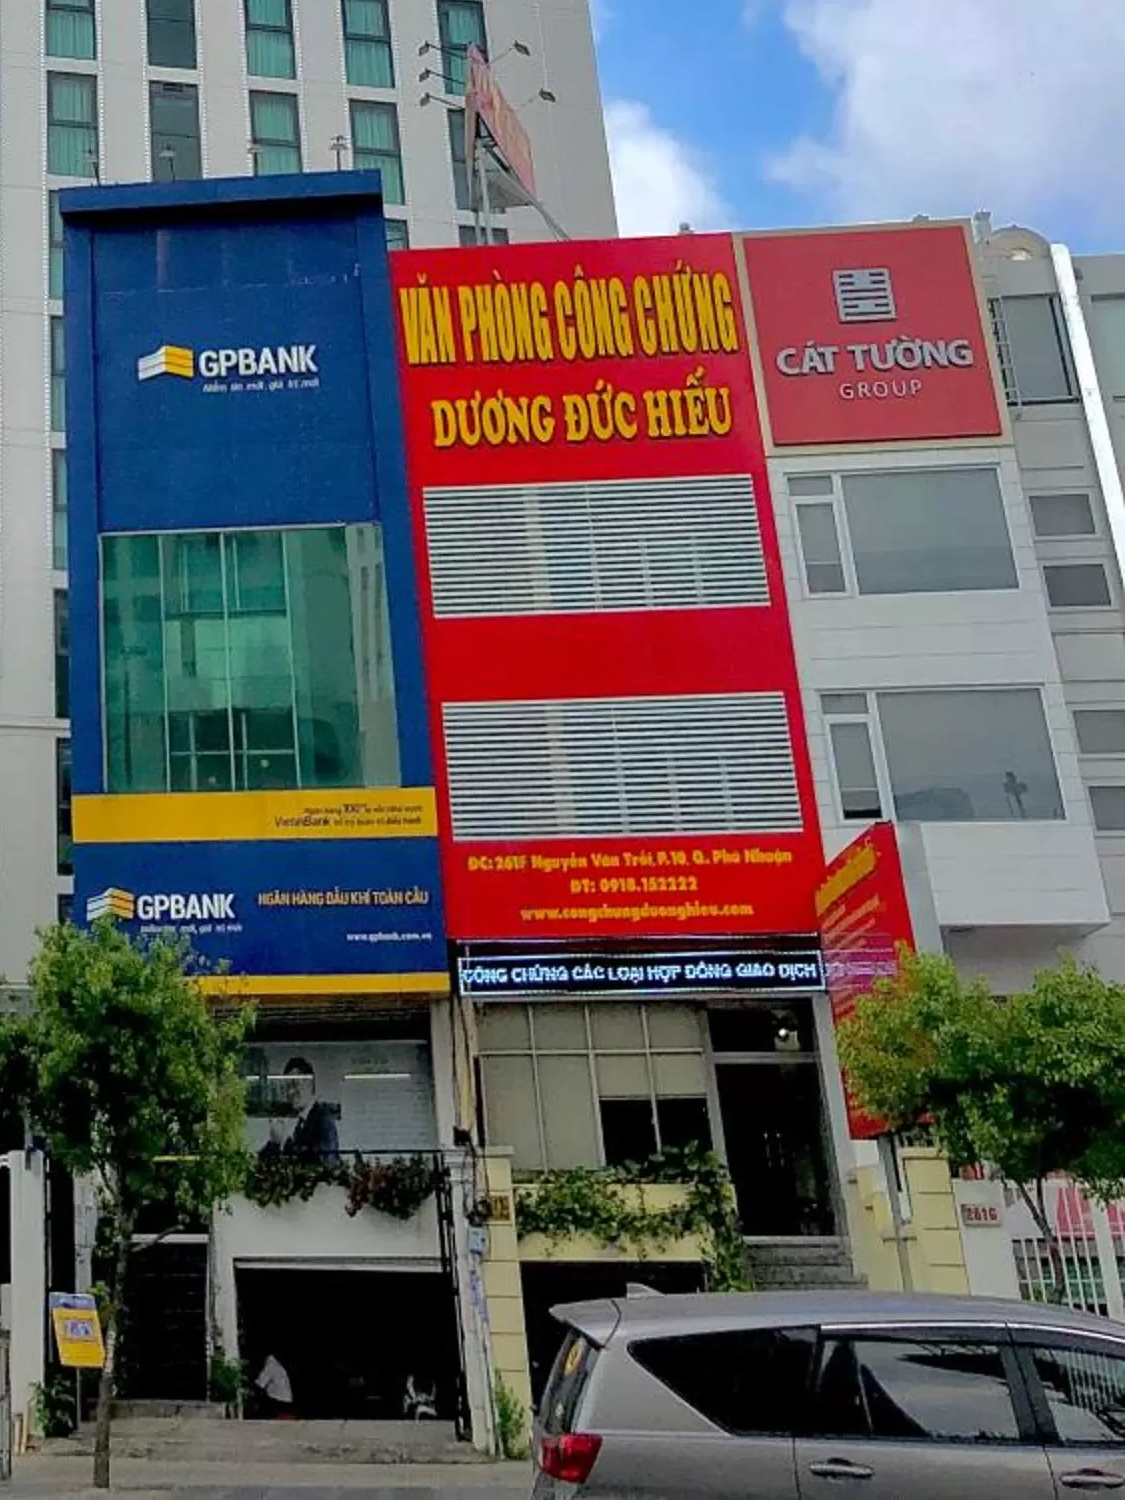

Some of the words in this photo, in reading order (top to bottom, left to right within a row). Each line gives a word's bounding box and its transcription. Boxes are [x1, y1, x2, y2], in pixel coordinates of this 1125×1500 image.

[399, 272, 456, 365] VĂN
[459, 268, 554, 363] PHÒNG
[554, 263, 634, 361] CÔNG
[634, 259, 739, 355] CHỨNG
[198, 344, 318, 378] GPBANK
[776, 340, 840, 376] CÁT
[847, 333, 974, 372] TƯỜNG
[839, 379, 922, 399] GROUP
[431, 388, 556, 448] DƯƠNG
[562, 378, 638, 443] ĐỨC
[645, 364, 732, 439] HIẾU
[600, 875, 698, 893] 0918.152222
[136, 893, 236, 920] GPBANK
[462, 967, 507, 983] CÔNG
[511, 964, 569, 983] CHỨNG
[572, 964, 605, 981] CÁC
[608, 967, 644, 984] LOẠI
[736, 963, 774, 978] GIAO
[779, 963, 817, 981] DỊCH
